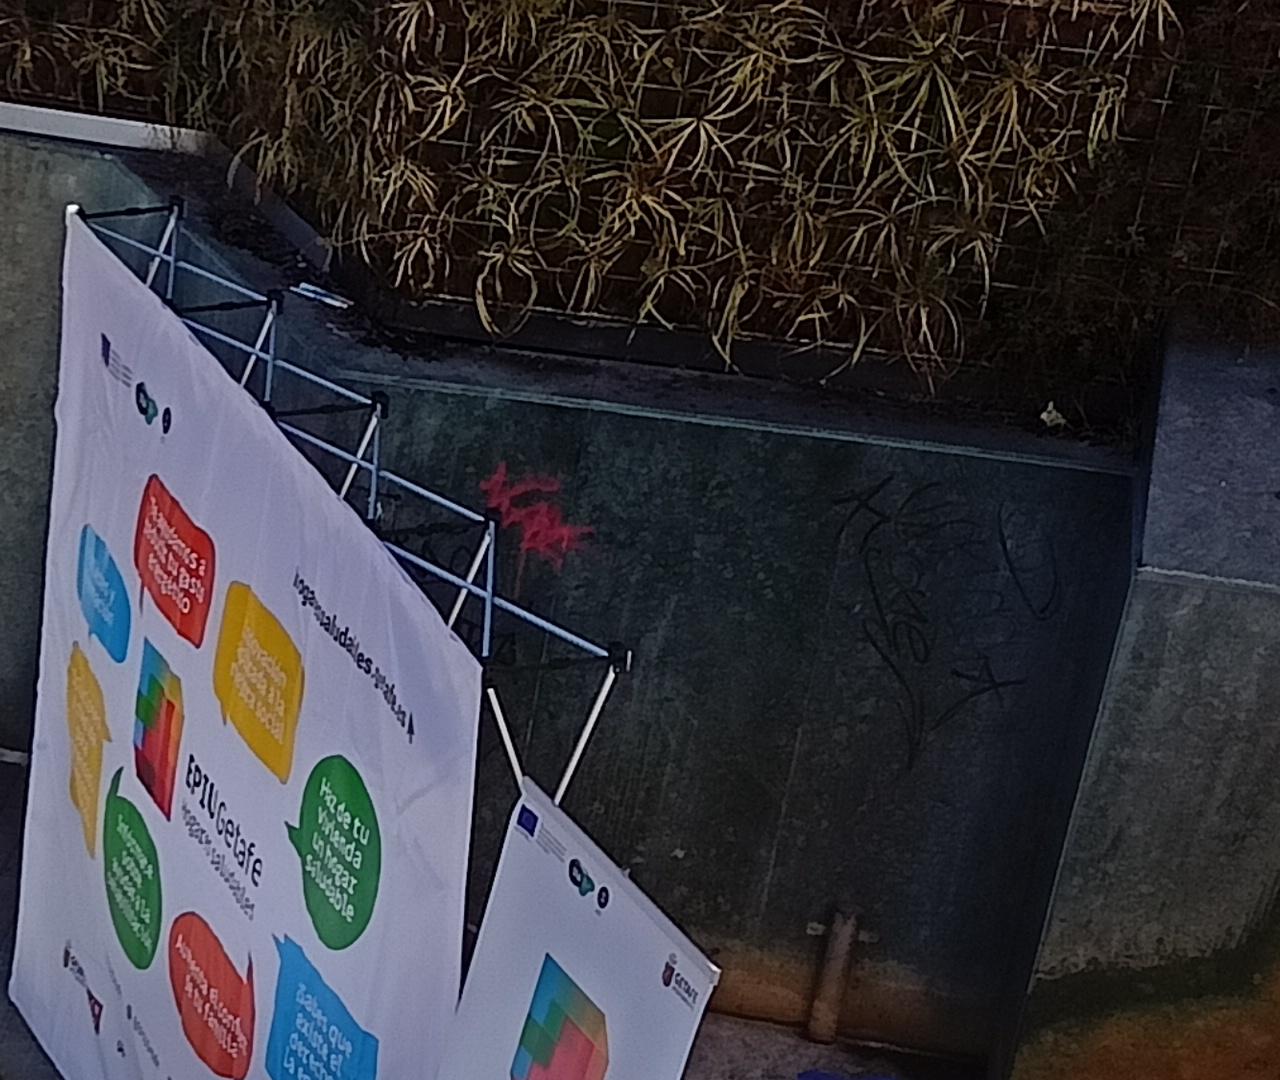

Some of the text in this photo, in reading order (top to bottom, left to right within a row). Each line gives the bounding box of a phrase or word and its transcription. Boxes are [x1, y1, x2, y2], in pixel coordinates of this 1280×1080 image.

[185, 753, 263, 888] EPIU Getafe
[336, 802, 351, 830] de
[353, 817, 370, 846] tu
[305, 854, 355, 922] saludable
[312, 832, 358, 895] un hogar
[295, 1012, 328, 1061] existe
[328, 1024, 353, 1059] que
